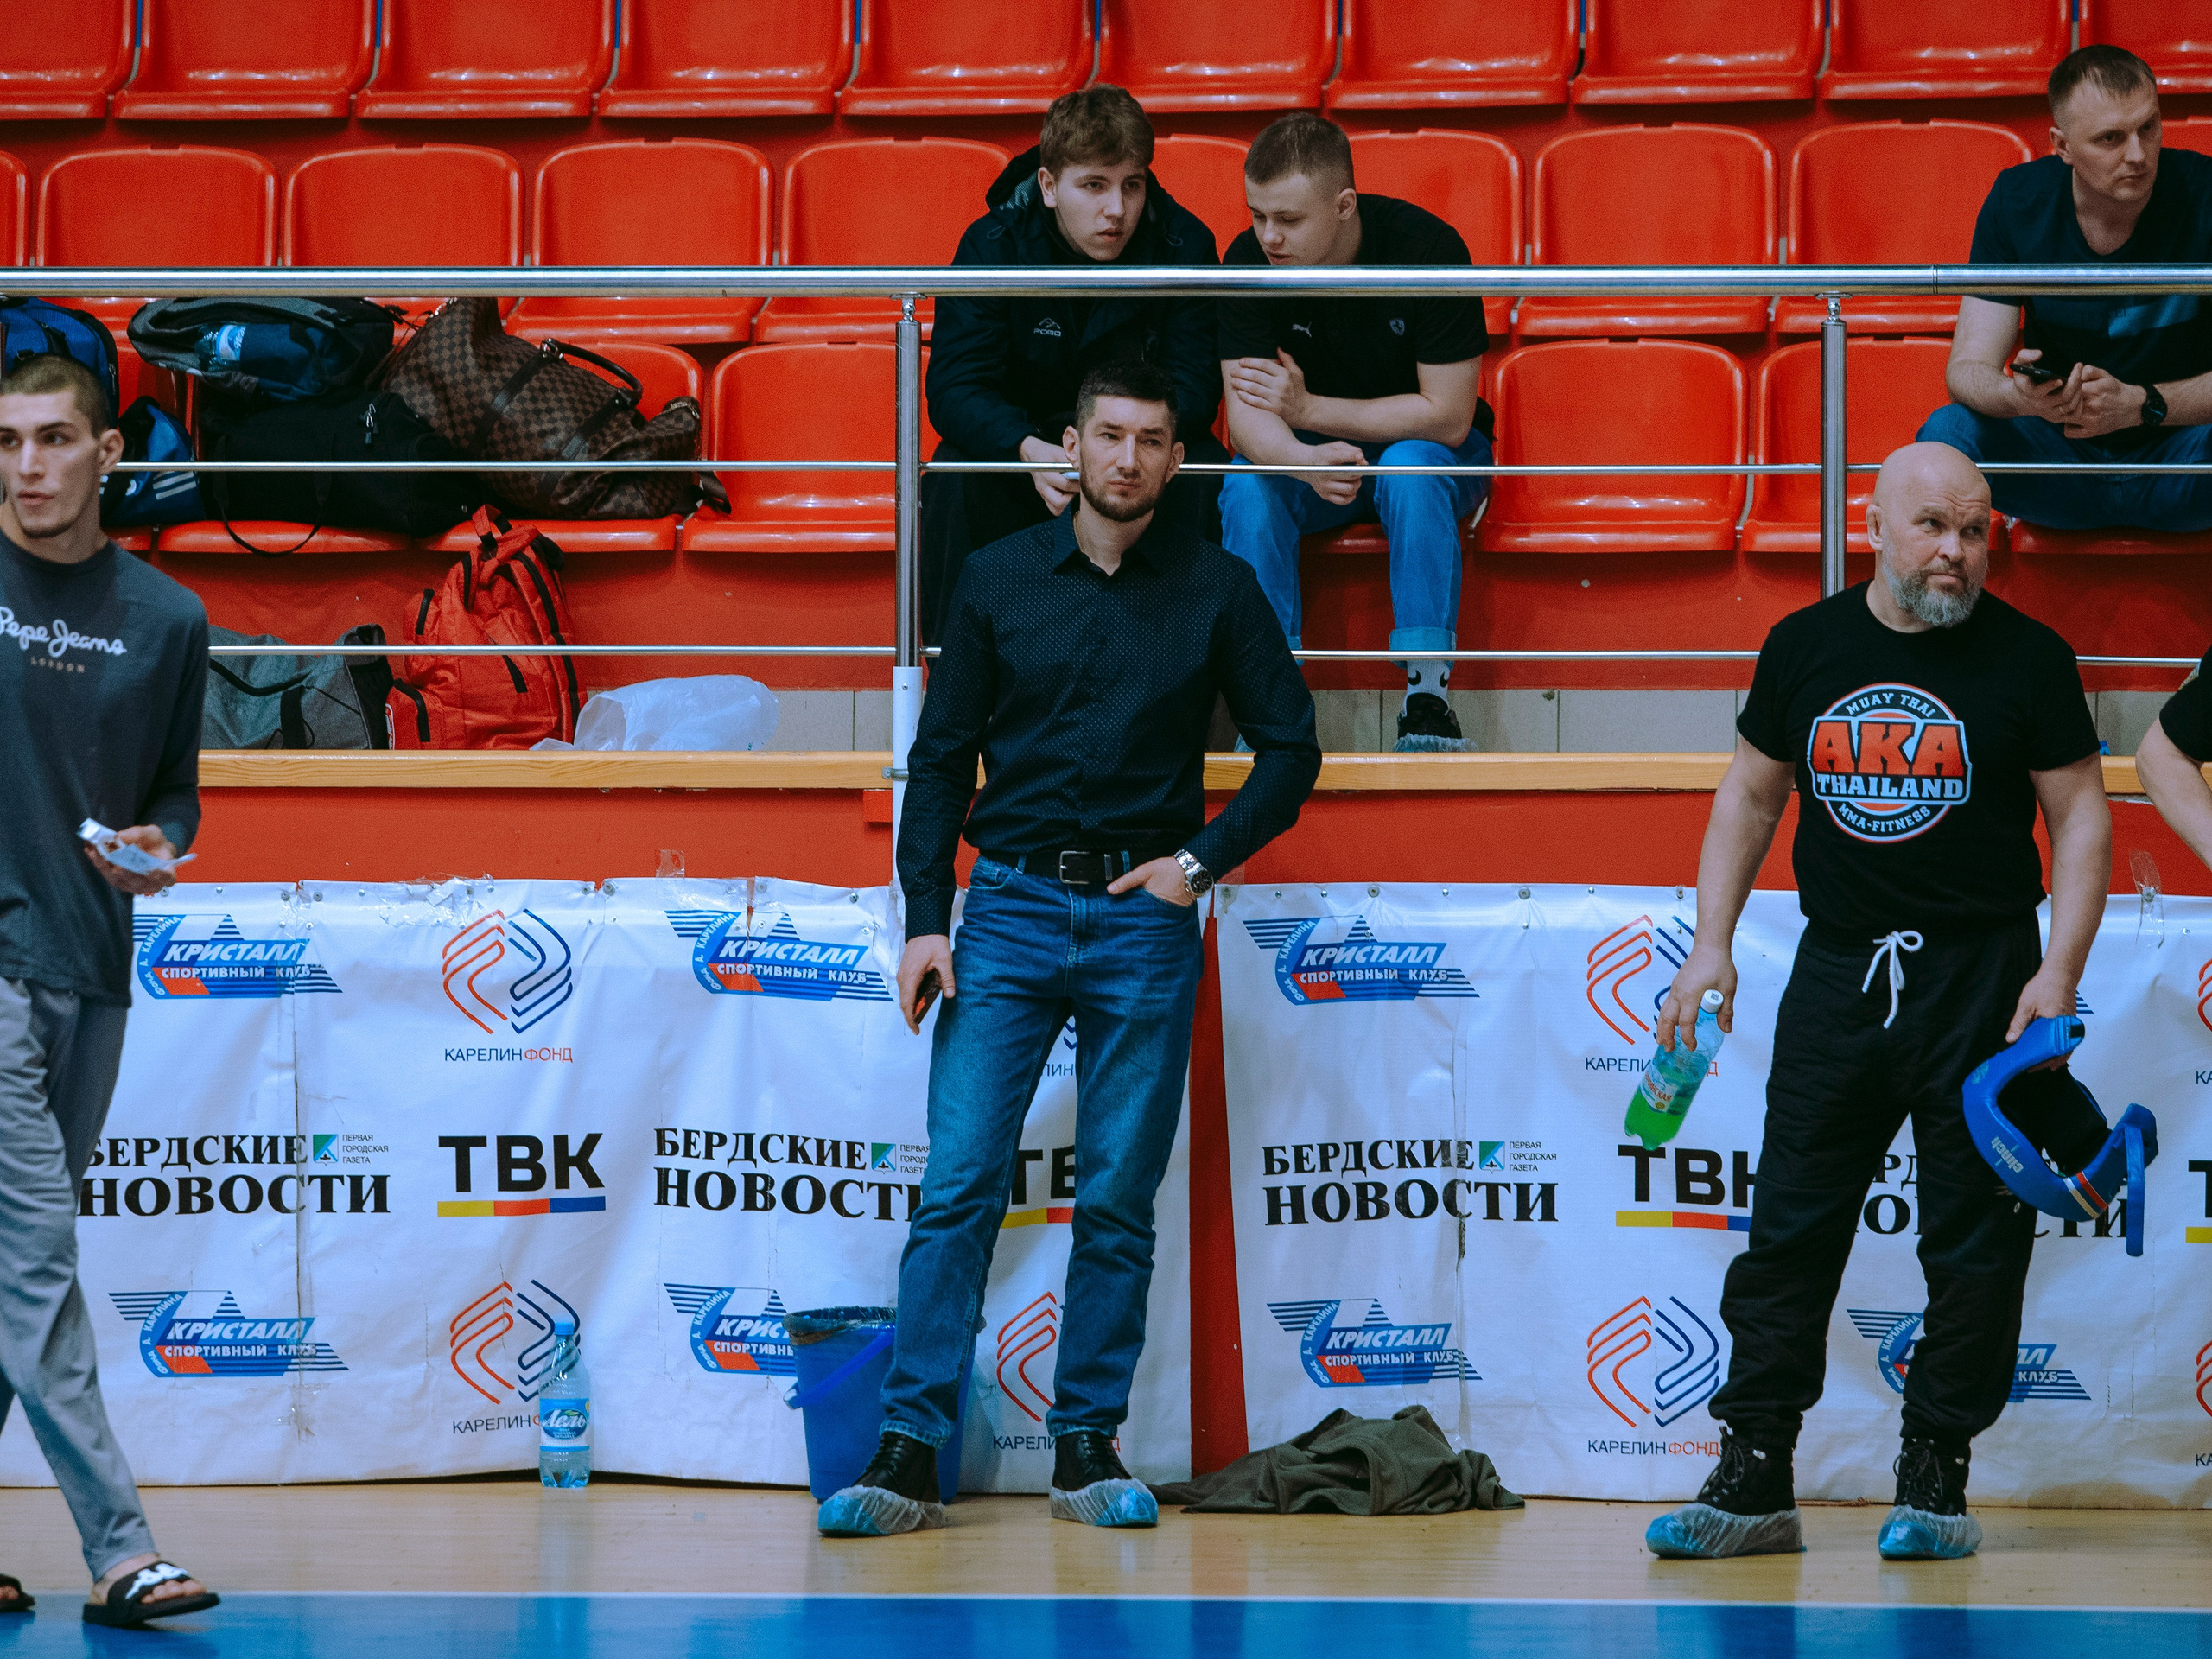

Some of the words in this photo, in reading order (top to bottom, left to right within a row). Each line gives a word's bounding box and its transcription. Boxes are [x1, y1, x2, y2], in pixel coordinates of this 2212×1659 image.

[0, 606, 50, 651] Pepe
[48, 619, 127, 658] Jeans
[1846, 693, 1894, 715] MUAY
[1900, 694, 1936, 719] THAI
[1812, 721, 1964, 777] AKA
[1816, 773, 1963, 798] THAILAND
[1838, 803, 1931, 833] MMA-FITNESS
[141, 916, 181, 953] КАРЕЛИНА
[696, 912, 735, 949] КАРЕЛИНА
[1278, 920, 1315, 959] КАРЕЛИНА
[162, 944, 302, 962] КРИСТАЛЛ
[719, 939, 860, 965] КРИСТАЛЛ
[1301, 945, 1437, 966] КРИСТАЛЛ
[162, 965, 265, 979] СПОРТИВНЫЙ
[276, 965, 311, 978] КЛУБ
[717, 963, 817, 980] СПОРТИВНЫЙ
[828, 969, 867, 984] КЛУБ
[1300, 969, 1398, 984] СПОРТИВНЫЙ
[1408, 969, 1447, 982] КЛУБ
[342, 1134, 373, 1142] ПЕРВАЯ
[342, 1145, 389, 1154] ГОРОДСКАЯ
[654, 1128, 867, 1170] БЕРДСКИЕ
[438, 1133, 605, 1192] ТВК
[1261, 1140, 1474, 1179] БЕРДСКИЕ
[1509, 1152, 1557, 1161] ГОРОДСКАЯ
[900, 1166, 925, 1174] ГАЗЕТ
[77, 1174, 391, 1217] НОВОСТИ
[1262, 1179, 1559, 1225] НОВОСТИ
[143, 1294, 183, 1332] КАРЕЛИНА
[694, 1290, 731, 1325] КАРЕЛИНА
[167, 1320, 305, 1339] КРИСТАЛЛ
[1303, 1301, 1338, 1341] КАРЕЛИНА
[1881, 1314, 1921, 1351] КАРЕЛИНА
[164, 1344, 267, 1357] СПОРТИВНЫЙ
[278, 1344, 316, 1356] КЛУБ
[1326, 1327, 1445, 1349] КРИСТАЛЛ
[1325, 1351, 1414, 1366] СПОРТИВНЫЙ
[1424, 1351, 1454, 1363] КЛУБ
[2018, 1371, 2058, 1383] КЛУБ
